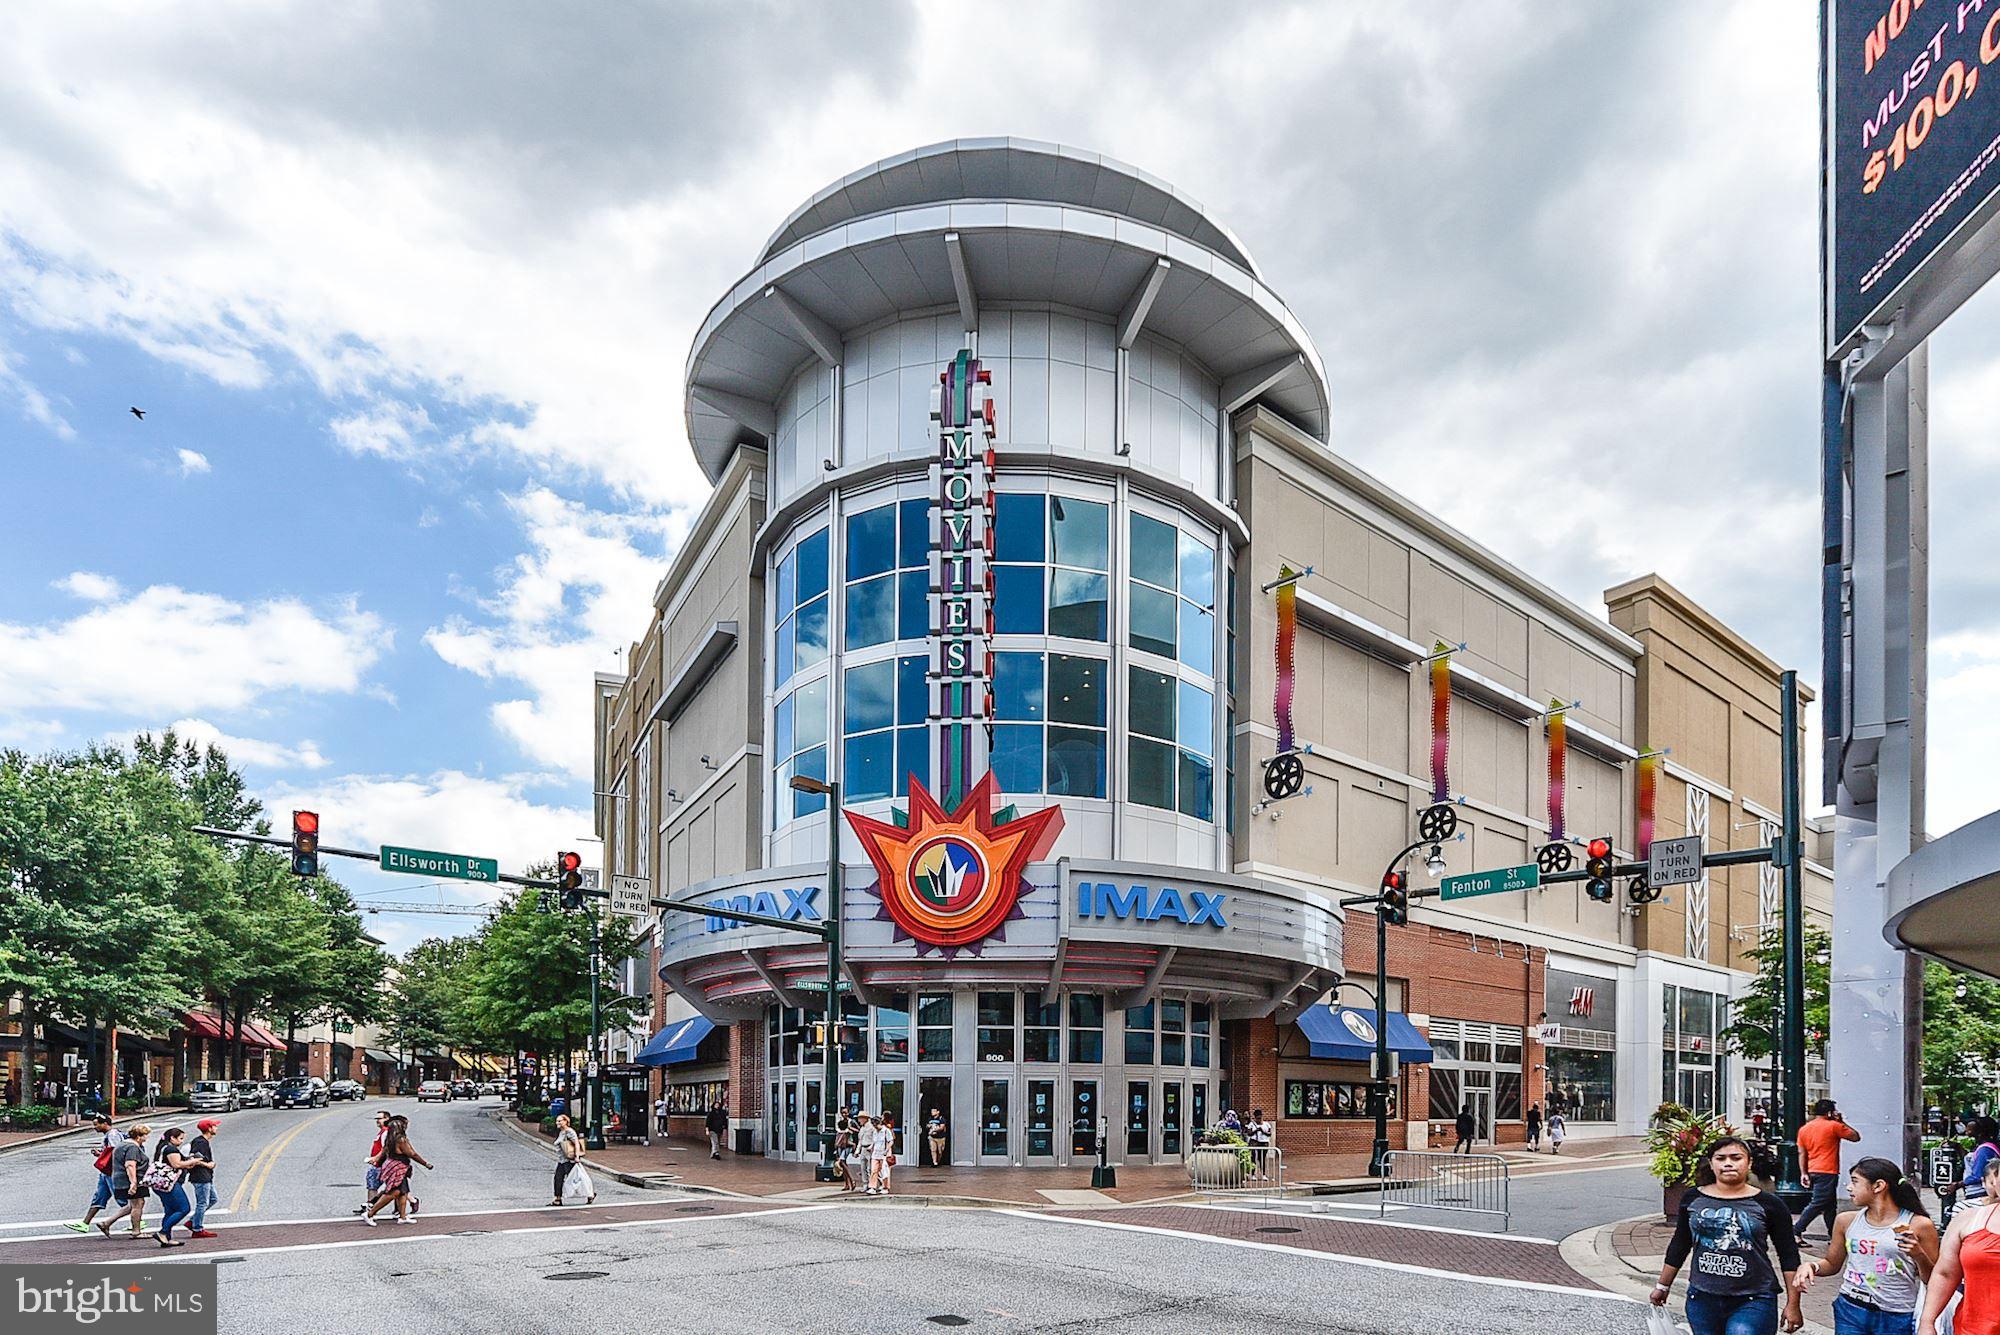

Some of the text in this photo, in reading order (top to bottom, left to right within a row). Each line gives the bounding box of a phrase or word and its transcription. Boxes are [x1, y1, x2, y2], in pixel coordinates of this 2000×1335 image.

[1864, 0, 1926, 76] NO
[1862, 22, 1950, 149] MUST
[943, 435, 973, 671] MOVIES
[1666, 844, 1685, 855] NO
[389, 852, 480, 873] Ellsworth Dr
[1660, 855, 1690, 868] TURN
[467, 870, 482, 878] 900
[1451, 868, 1518, 895] Fenton St
[1654, 867, 1697, 881] ON RED
[624, 880, 640, 890] NO
[619, 890, 643, 901] TURN
[613, 900, 647, 912] ON RED
[704, 886, 821, 933] IMAX
[1078, 882, 1229, 928] IMAX
[1699, 1251, 1746, 1269] STAR
[1699, 1261, 1746, 1278] WARS
